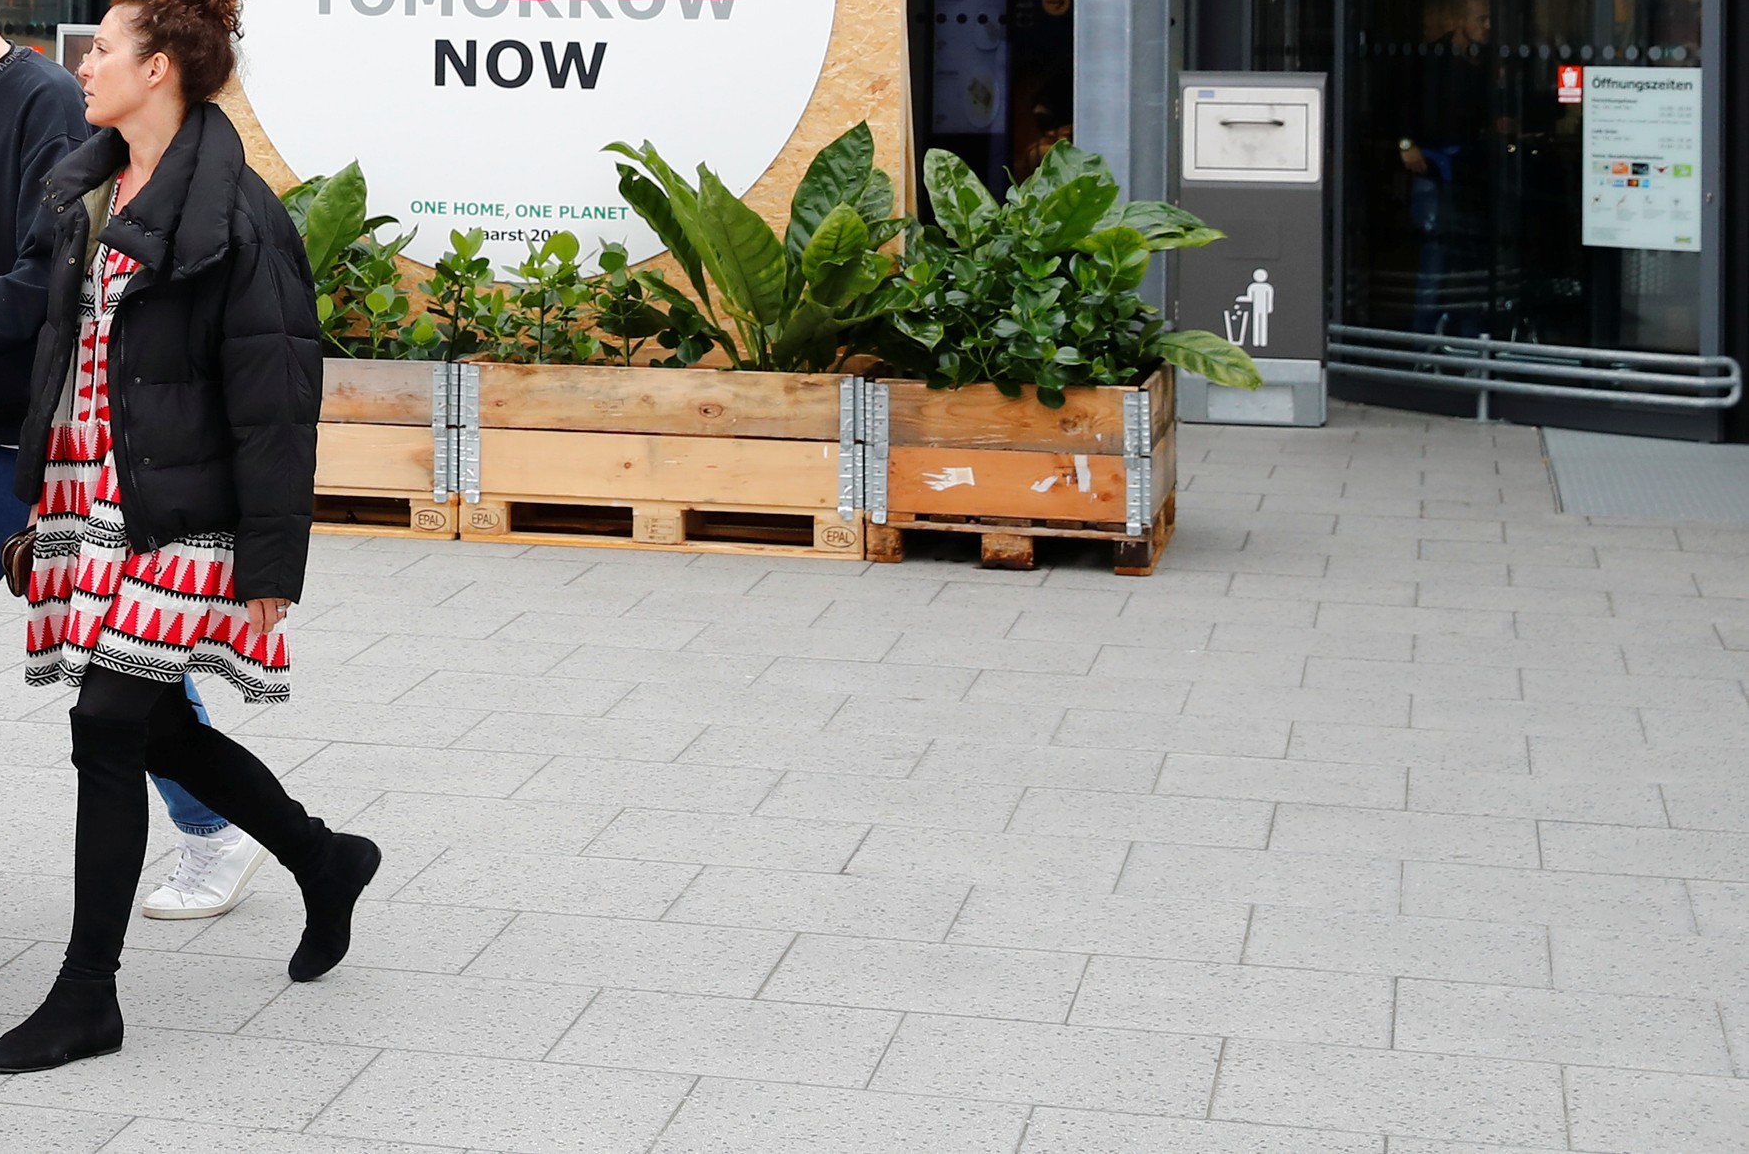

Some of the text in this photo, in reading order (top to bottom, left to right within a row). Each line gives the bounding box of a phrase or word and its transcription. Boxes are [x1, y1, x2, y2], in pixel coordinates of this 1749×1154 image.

[434, 39, 608, 90] NOW
[1591, 76, 1693, 92] Öffnungszeiten
[410, 201, 629, 220] ONE HOME, ONE PLANET
[468, 227, 524, 242] aarst
[418, 514, 442, 528] EPAL
[471, 512, 496, 526] EPAL
[826, 530, 851, 544] EPAL
